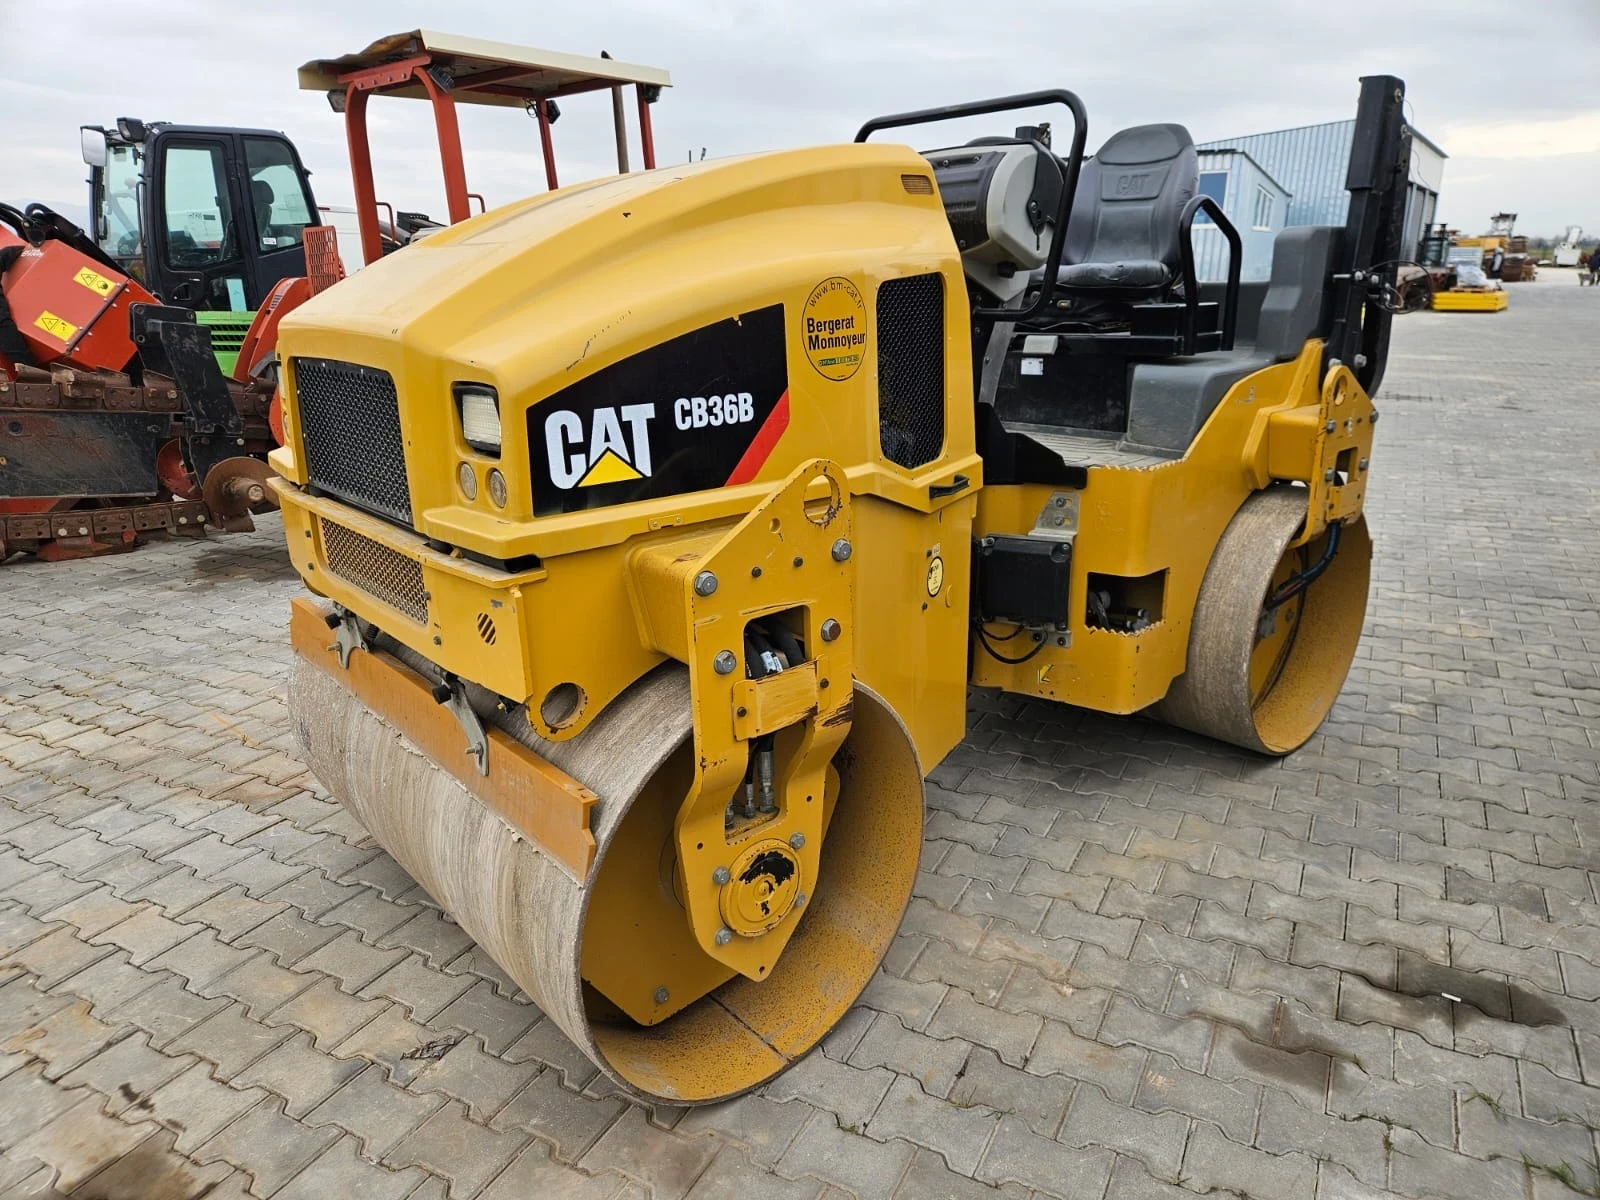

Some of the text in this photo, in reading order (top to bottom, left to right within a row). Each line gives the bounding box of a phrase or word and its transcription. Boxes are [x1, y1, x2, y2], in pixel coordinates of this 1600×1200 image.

[1117, 174, 1151, 195] CAT
[806, 315, 854, 334] Bergerat
[808, 333, 865, 350] Monnoyeur
[674, 392, 754, 430] CB36B
[545, 403, 655, 489] CAT
